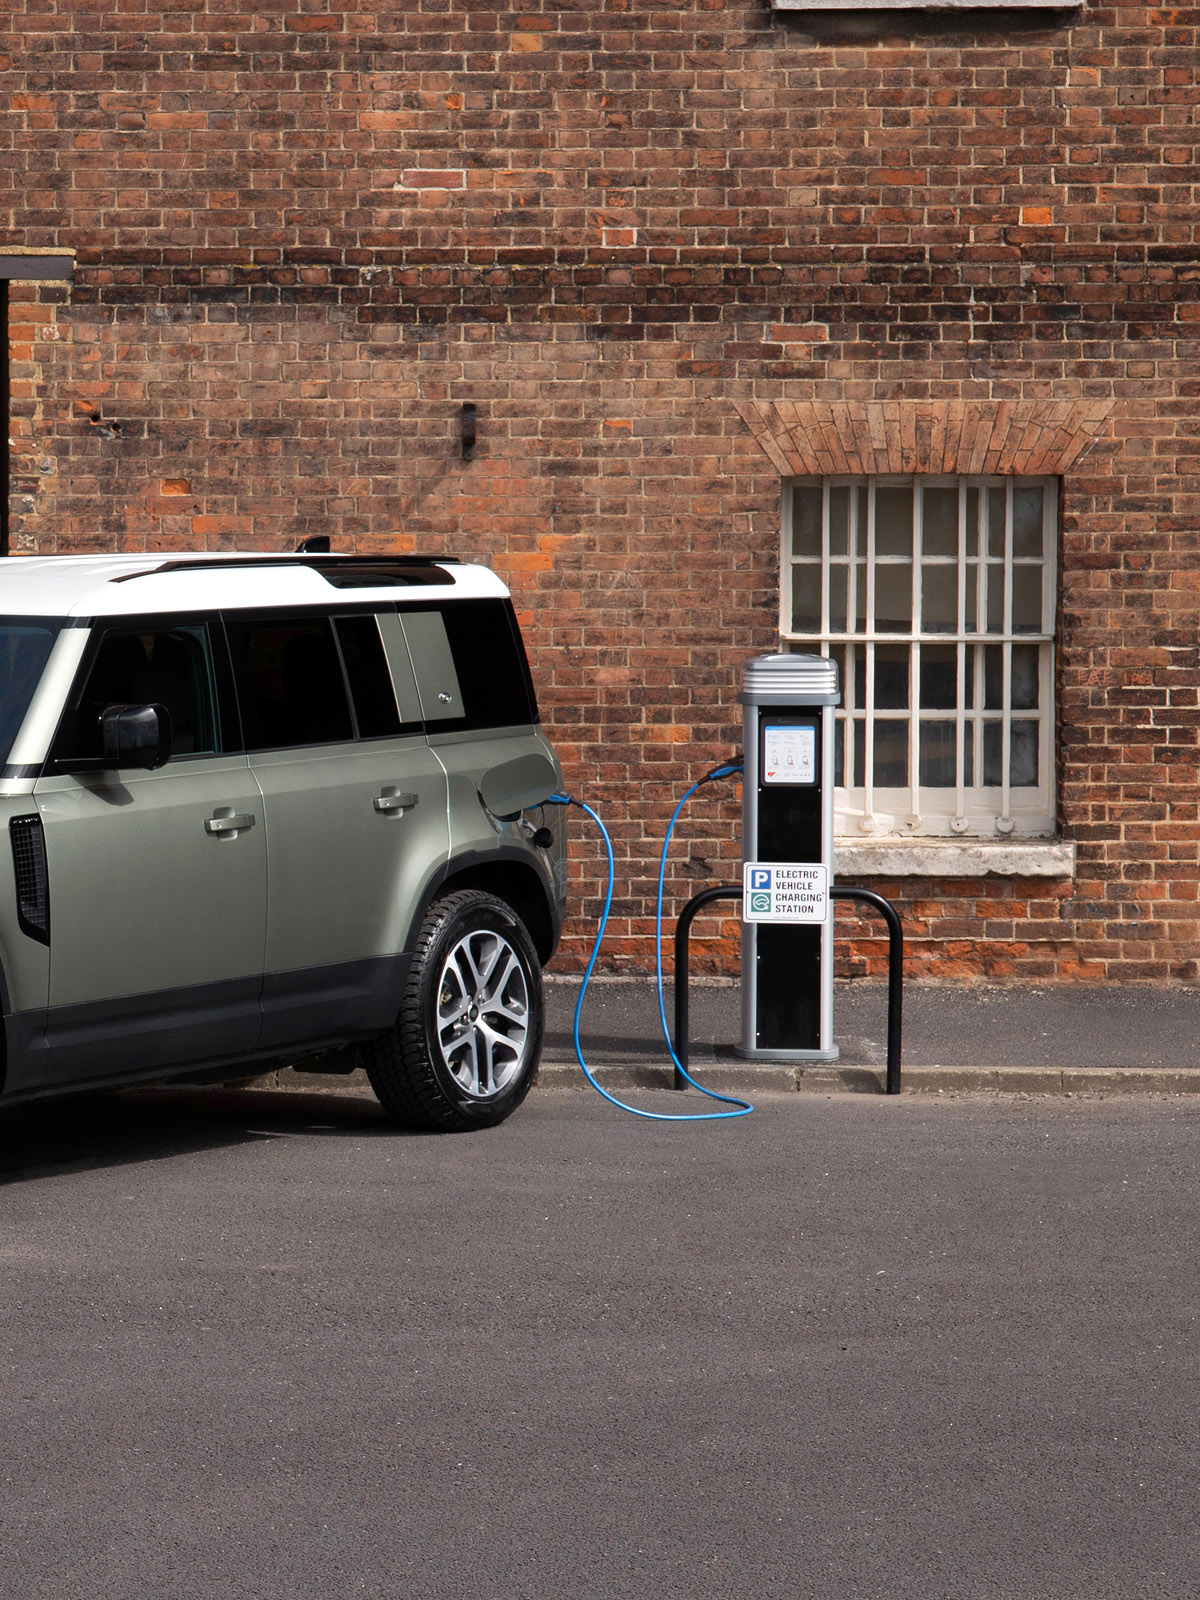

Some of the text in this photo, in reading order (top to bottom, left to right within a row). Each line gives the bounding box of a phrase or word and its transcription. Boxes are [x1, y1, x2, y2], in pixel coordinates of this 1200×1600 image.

[776, 870, 819, 879] ELECTRIC
[755, 871, 769, 888] P
[776, 881, 813, 890] VEHICLE
[775, 893, 822, 902] CHARGING
[775, 904, 814, 913] STATION
